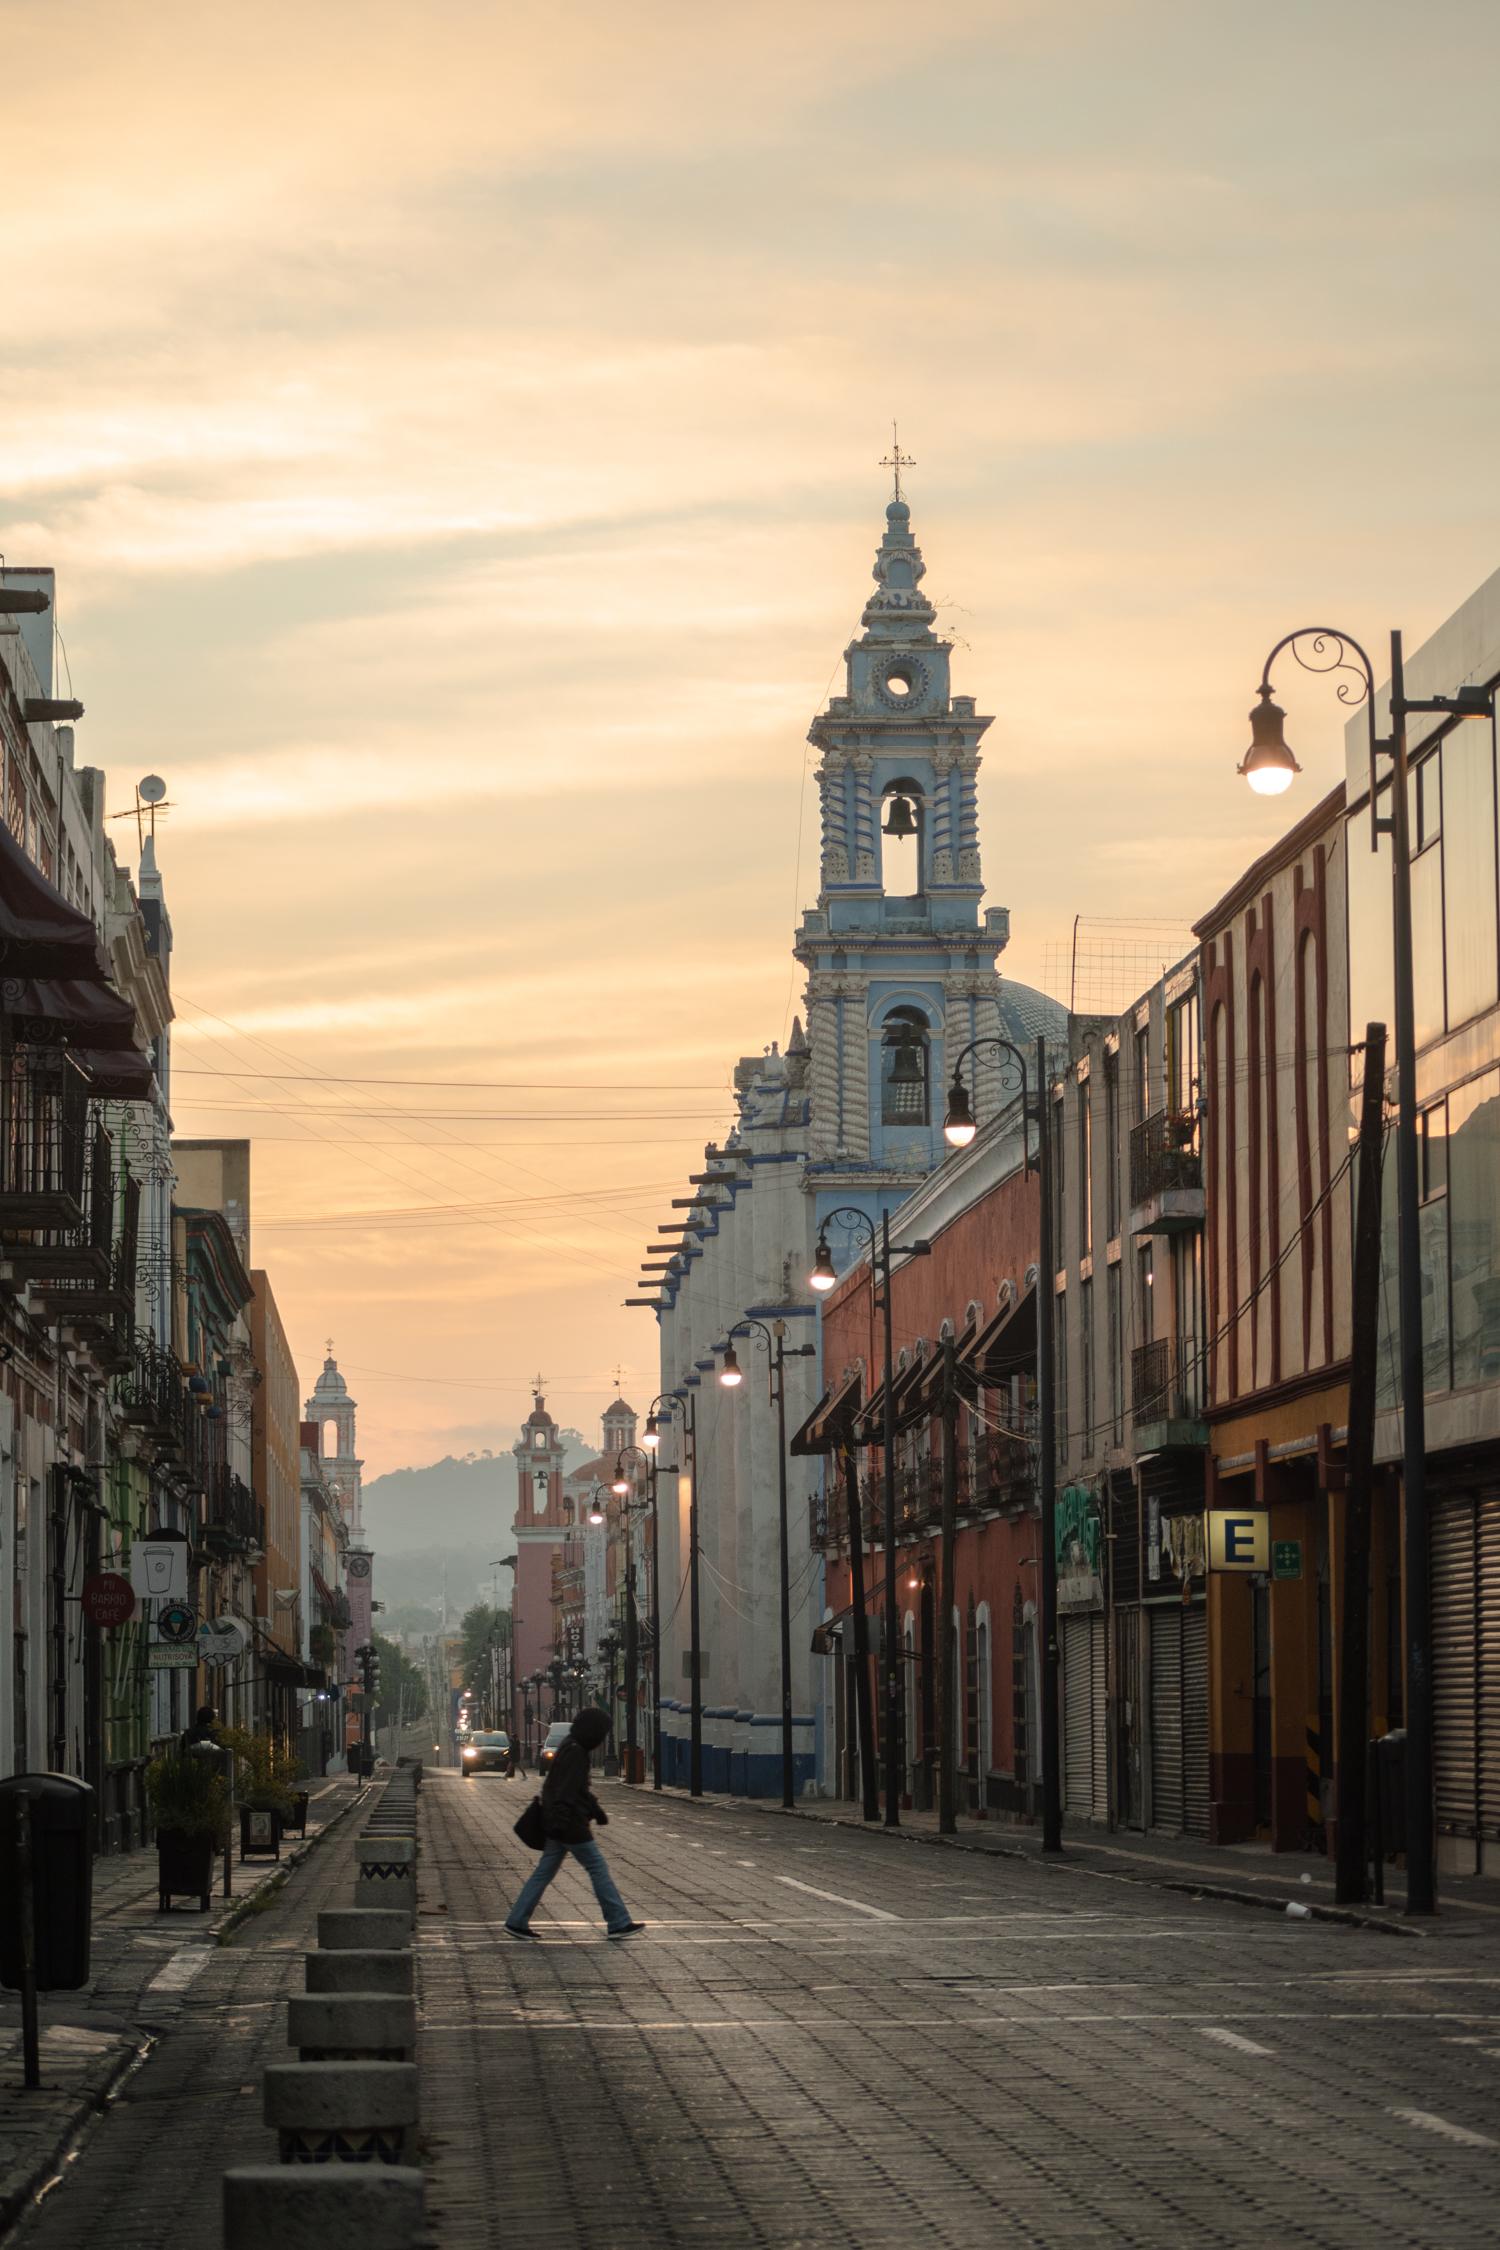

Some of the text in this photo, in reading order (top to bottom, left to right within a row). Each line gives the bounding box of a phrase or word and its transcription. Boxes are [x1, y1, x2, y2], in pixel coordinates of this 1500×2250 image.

[1225, 1519, 1254, 1563] E
[91, 1592, 127, 1607] BARRIO
[153, 1652, 193, 1661] NUTRISOYA
